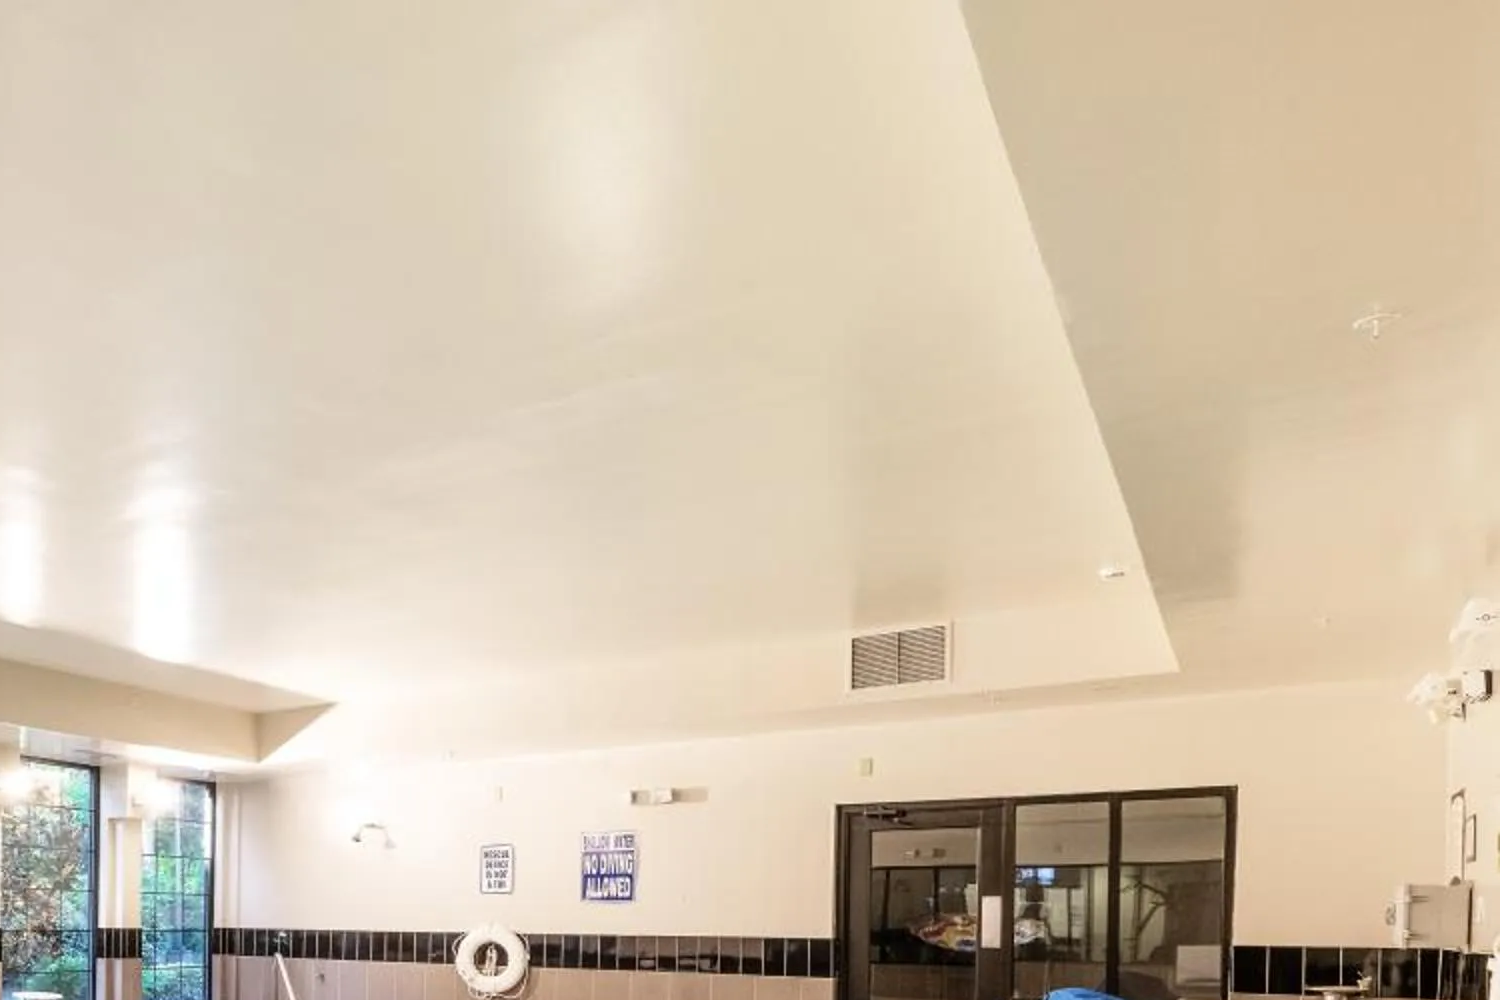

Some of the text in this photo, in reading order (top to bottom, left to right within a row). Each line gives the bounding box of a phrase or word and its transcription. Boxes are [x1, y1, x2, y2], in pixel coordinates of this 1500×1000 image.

[583, 852, 633, 874] NO DIVING
[586, 877, 631, 897] ALLOWED
